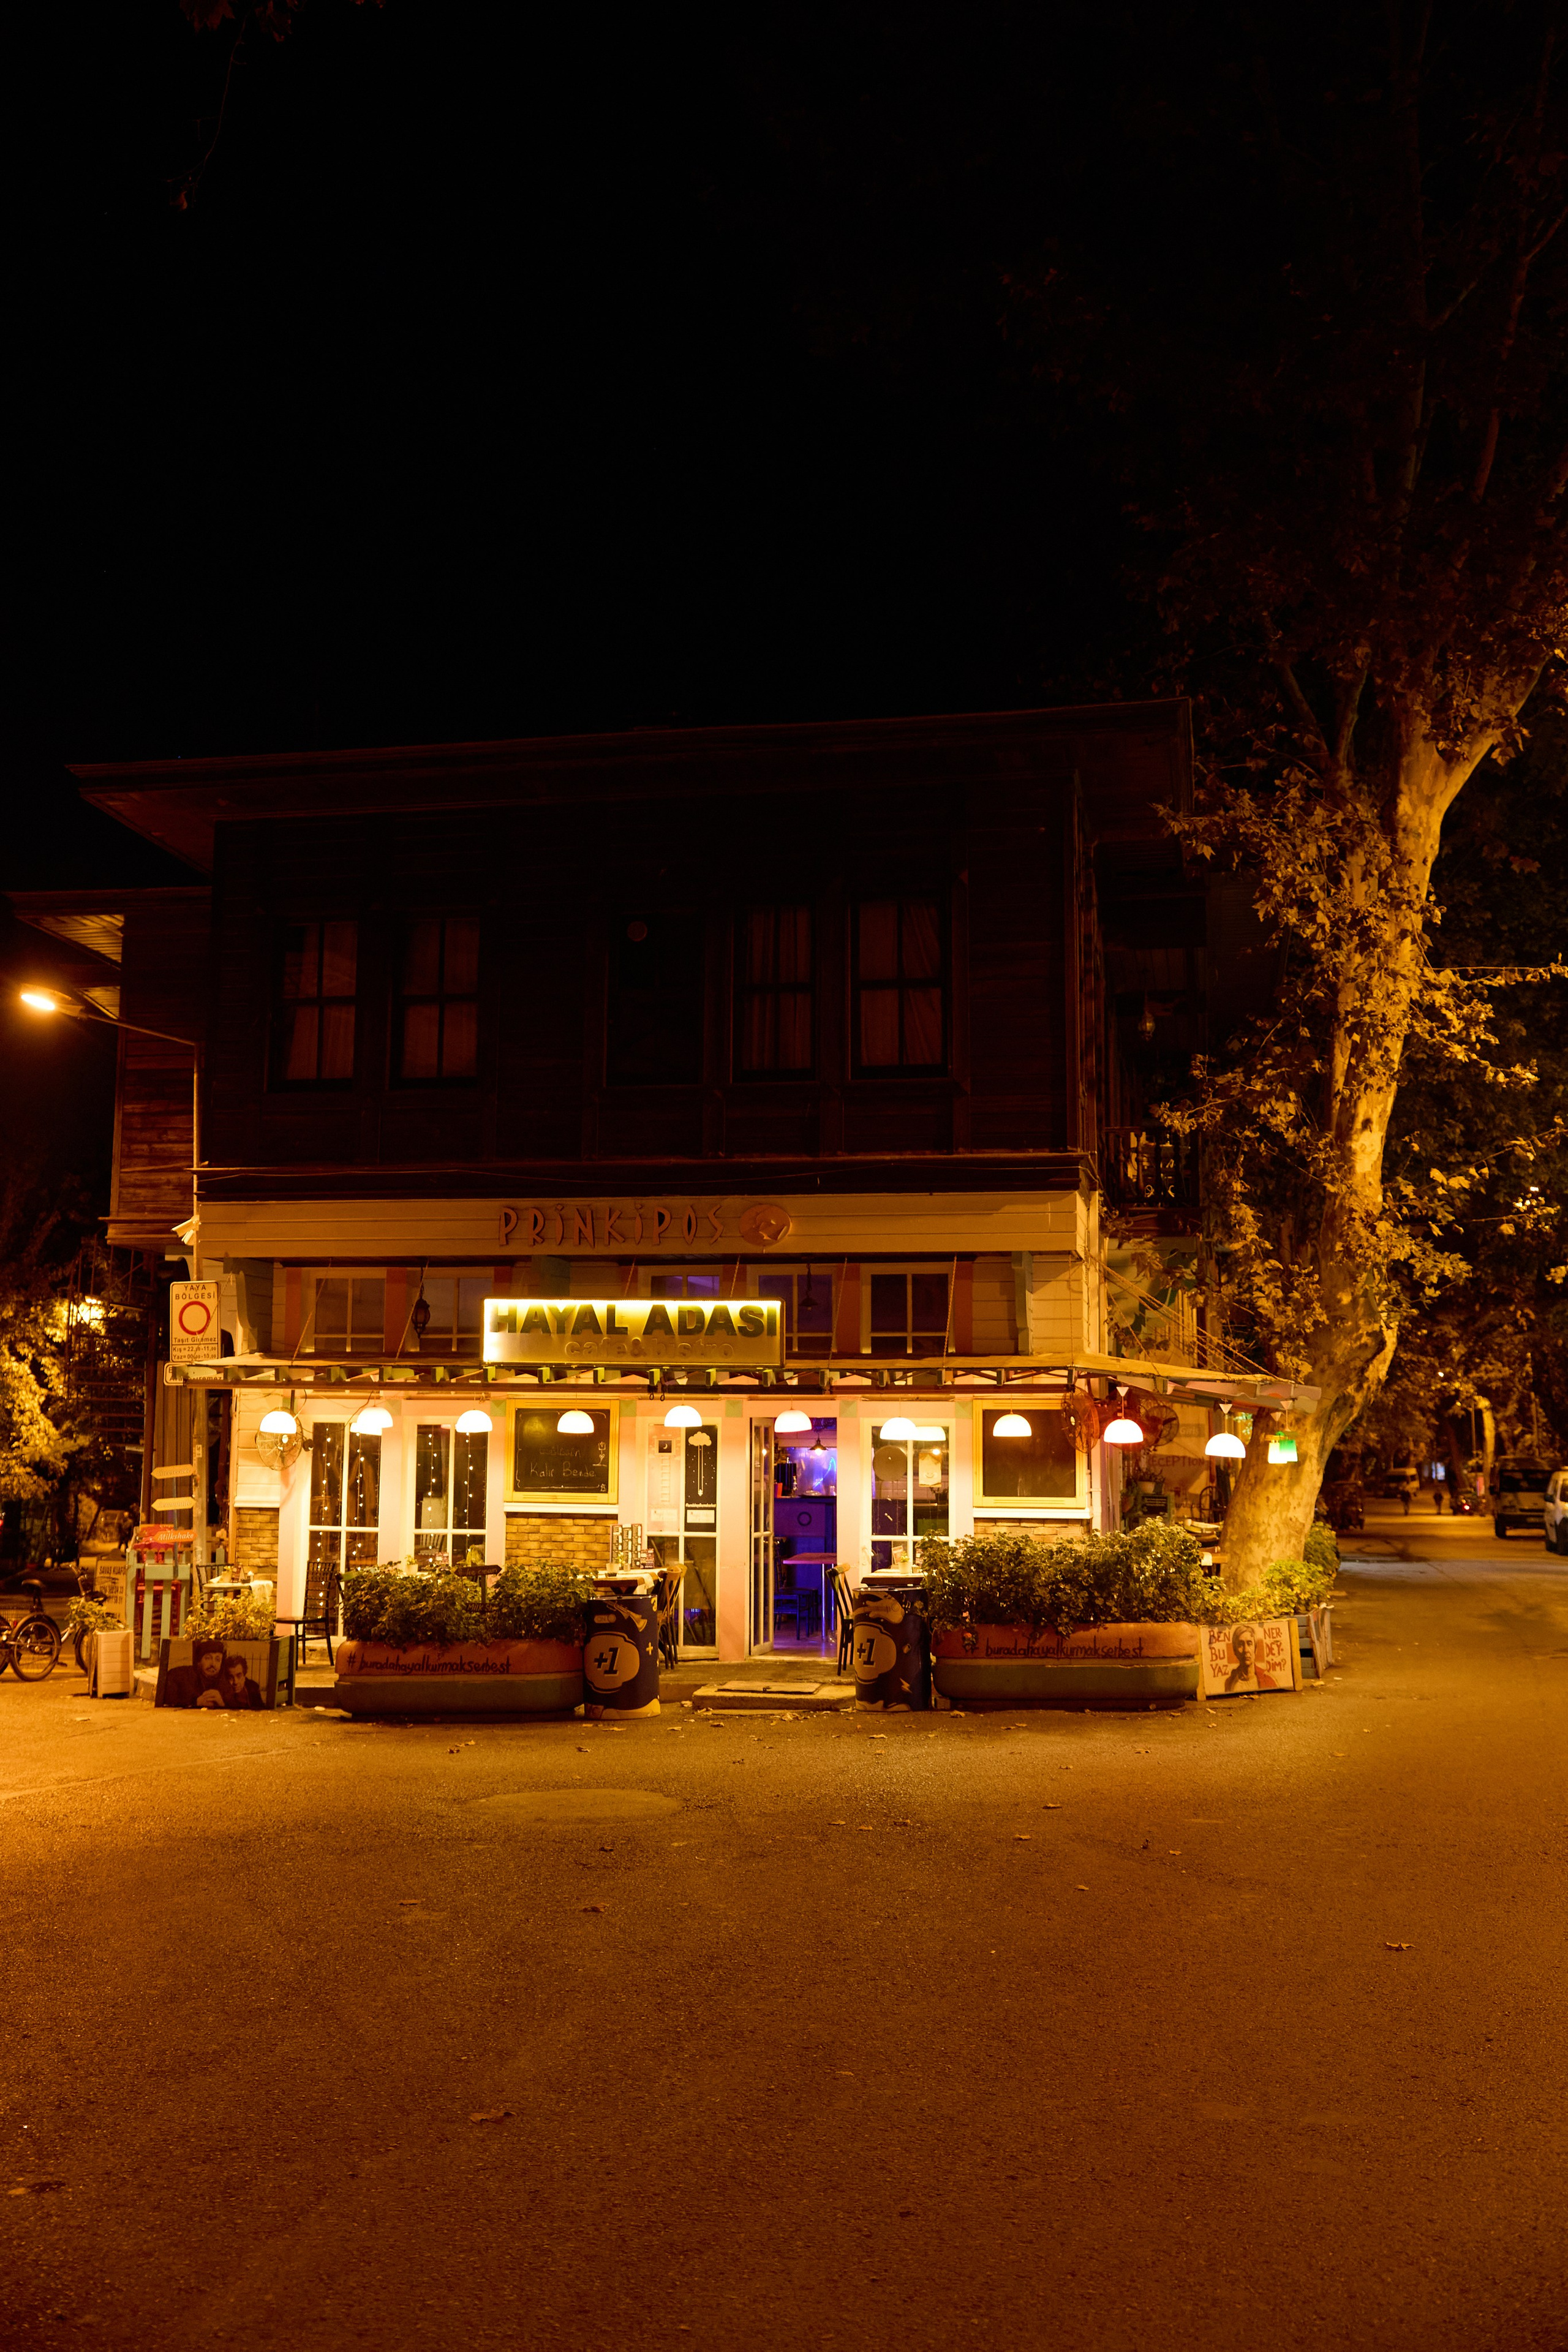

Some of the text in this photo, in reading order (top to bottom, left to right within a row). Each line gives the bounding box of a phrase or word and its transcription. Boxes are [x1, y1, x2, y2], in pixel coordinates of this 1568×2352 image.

[175, 1291, 215, 1300] BÖLGESİ
[489, 1304, 777, 1337] HAYAL ADASI
[158, 1531, 194, 1541] Milkshake
[1208, 1630, 1231, 1645] BEN
[857, 1638, 875, 1666] +1
[1210, 1647, 1225, 1662] BU
[594, 1647, 619, 1675] +1
[1210, 1664, 1229, 1678] YAZ
